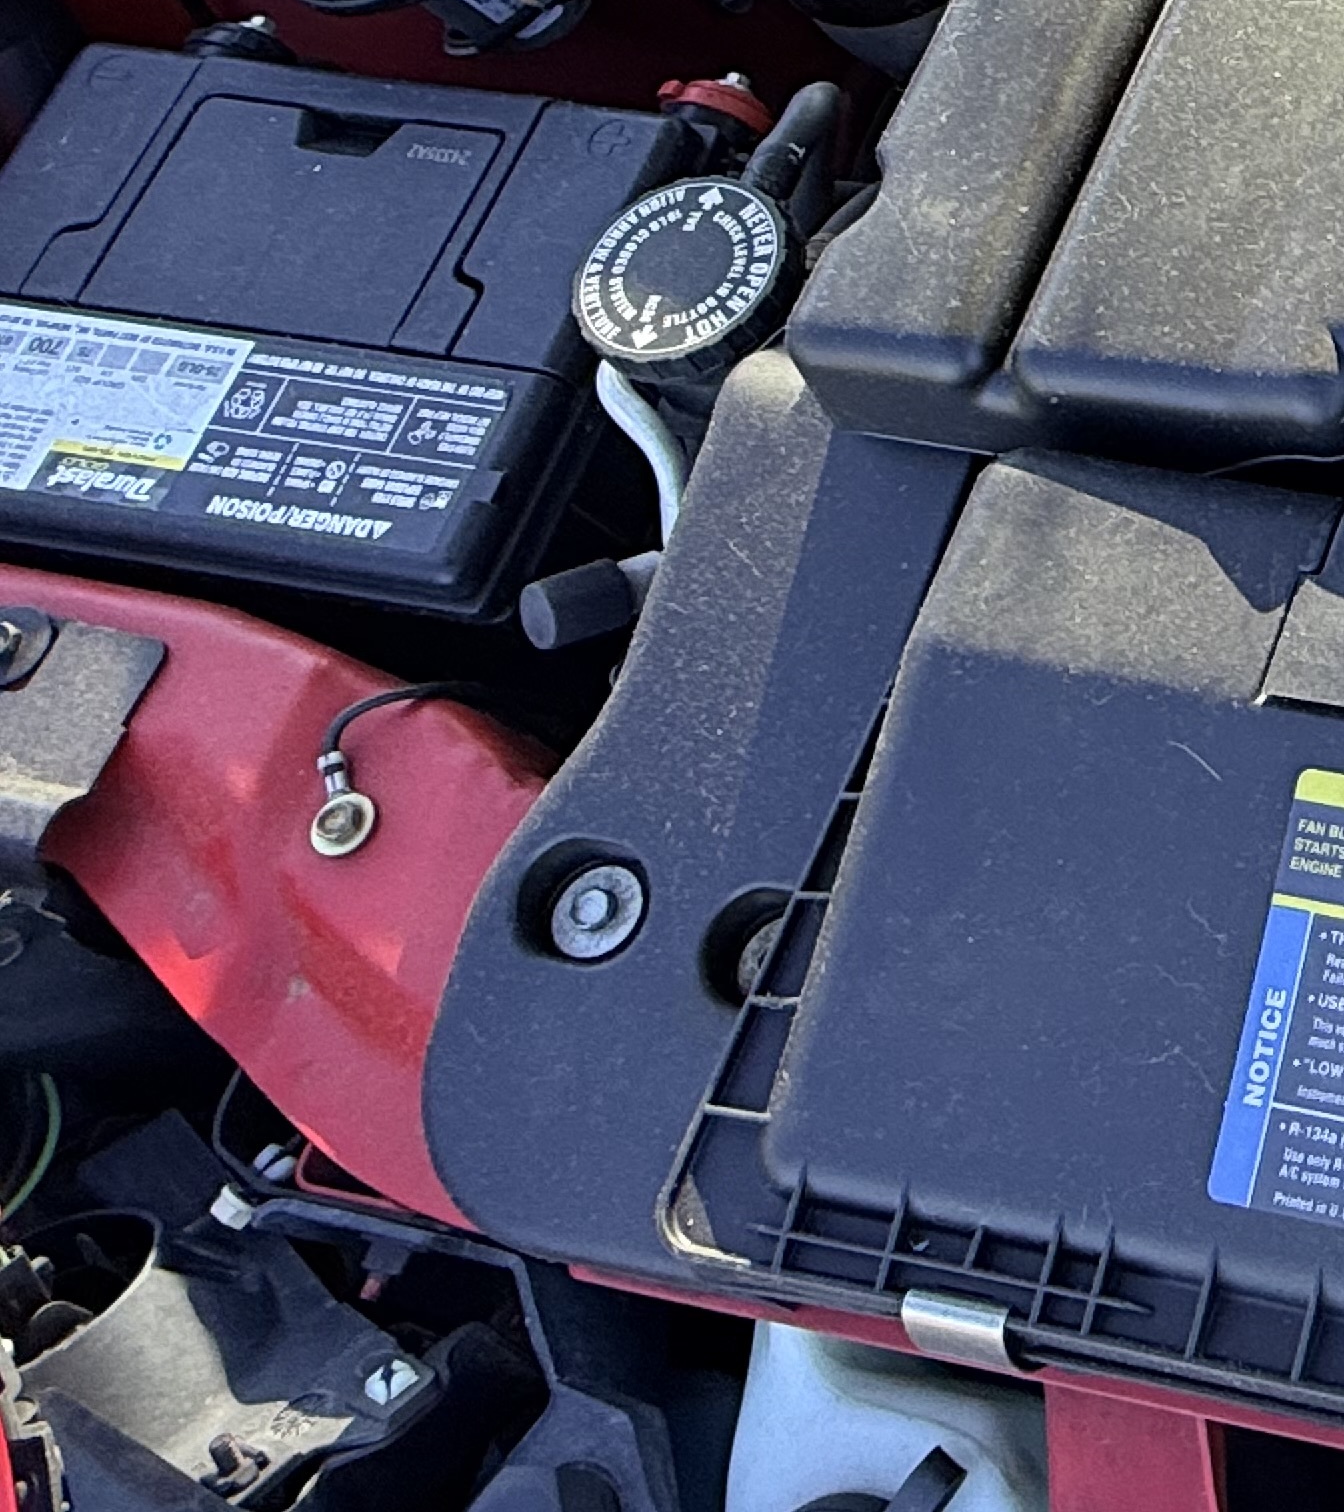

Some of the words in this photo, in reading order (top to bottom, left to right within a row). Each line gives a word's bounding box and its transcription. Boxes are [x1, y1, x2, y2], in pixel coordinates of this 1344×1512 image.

[738, 203, 775, 258] NEVER
[726, 262, 770, 312] OPEN
[28, 336, 64, 355] 700
[683, 309, 729, 345] HOT
[47, 464, 156, 501] Duralast
[206, 494, 376, 537] DANGER/POISON
[1297, 818, 1326, 836] FAN
[1288, 855, 1342, 879] ENGINE
[1240, 985, 1288, 1108] NOTICE
